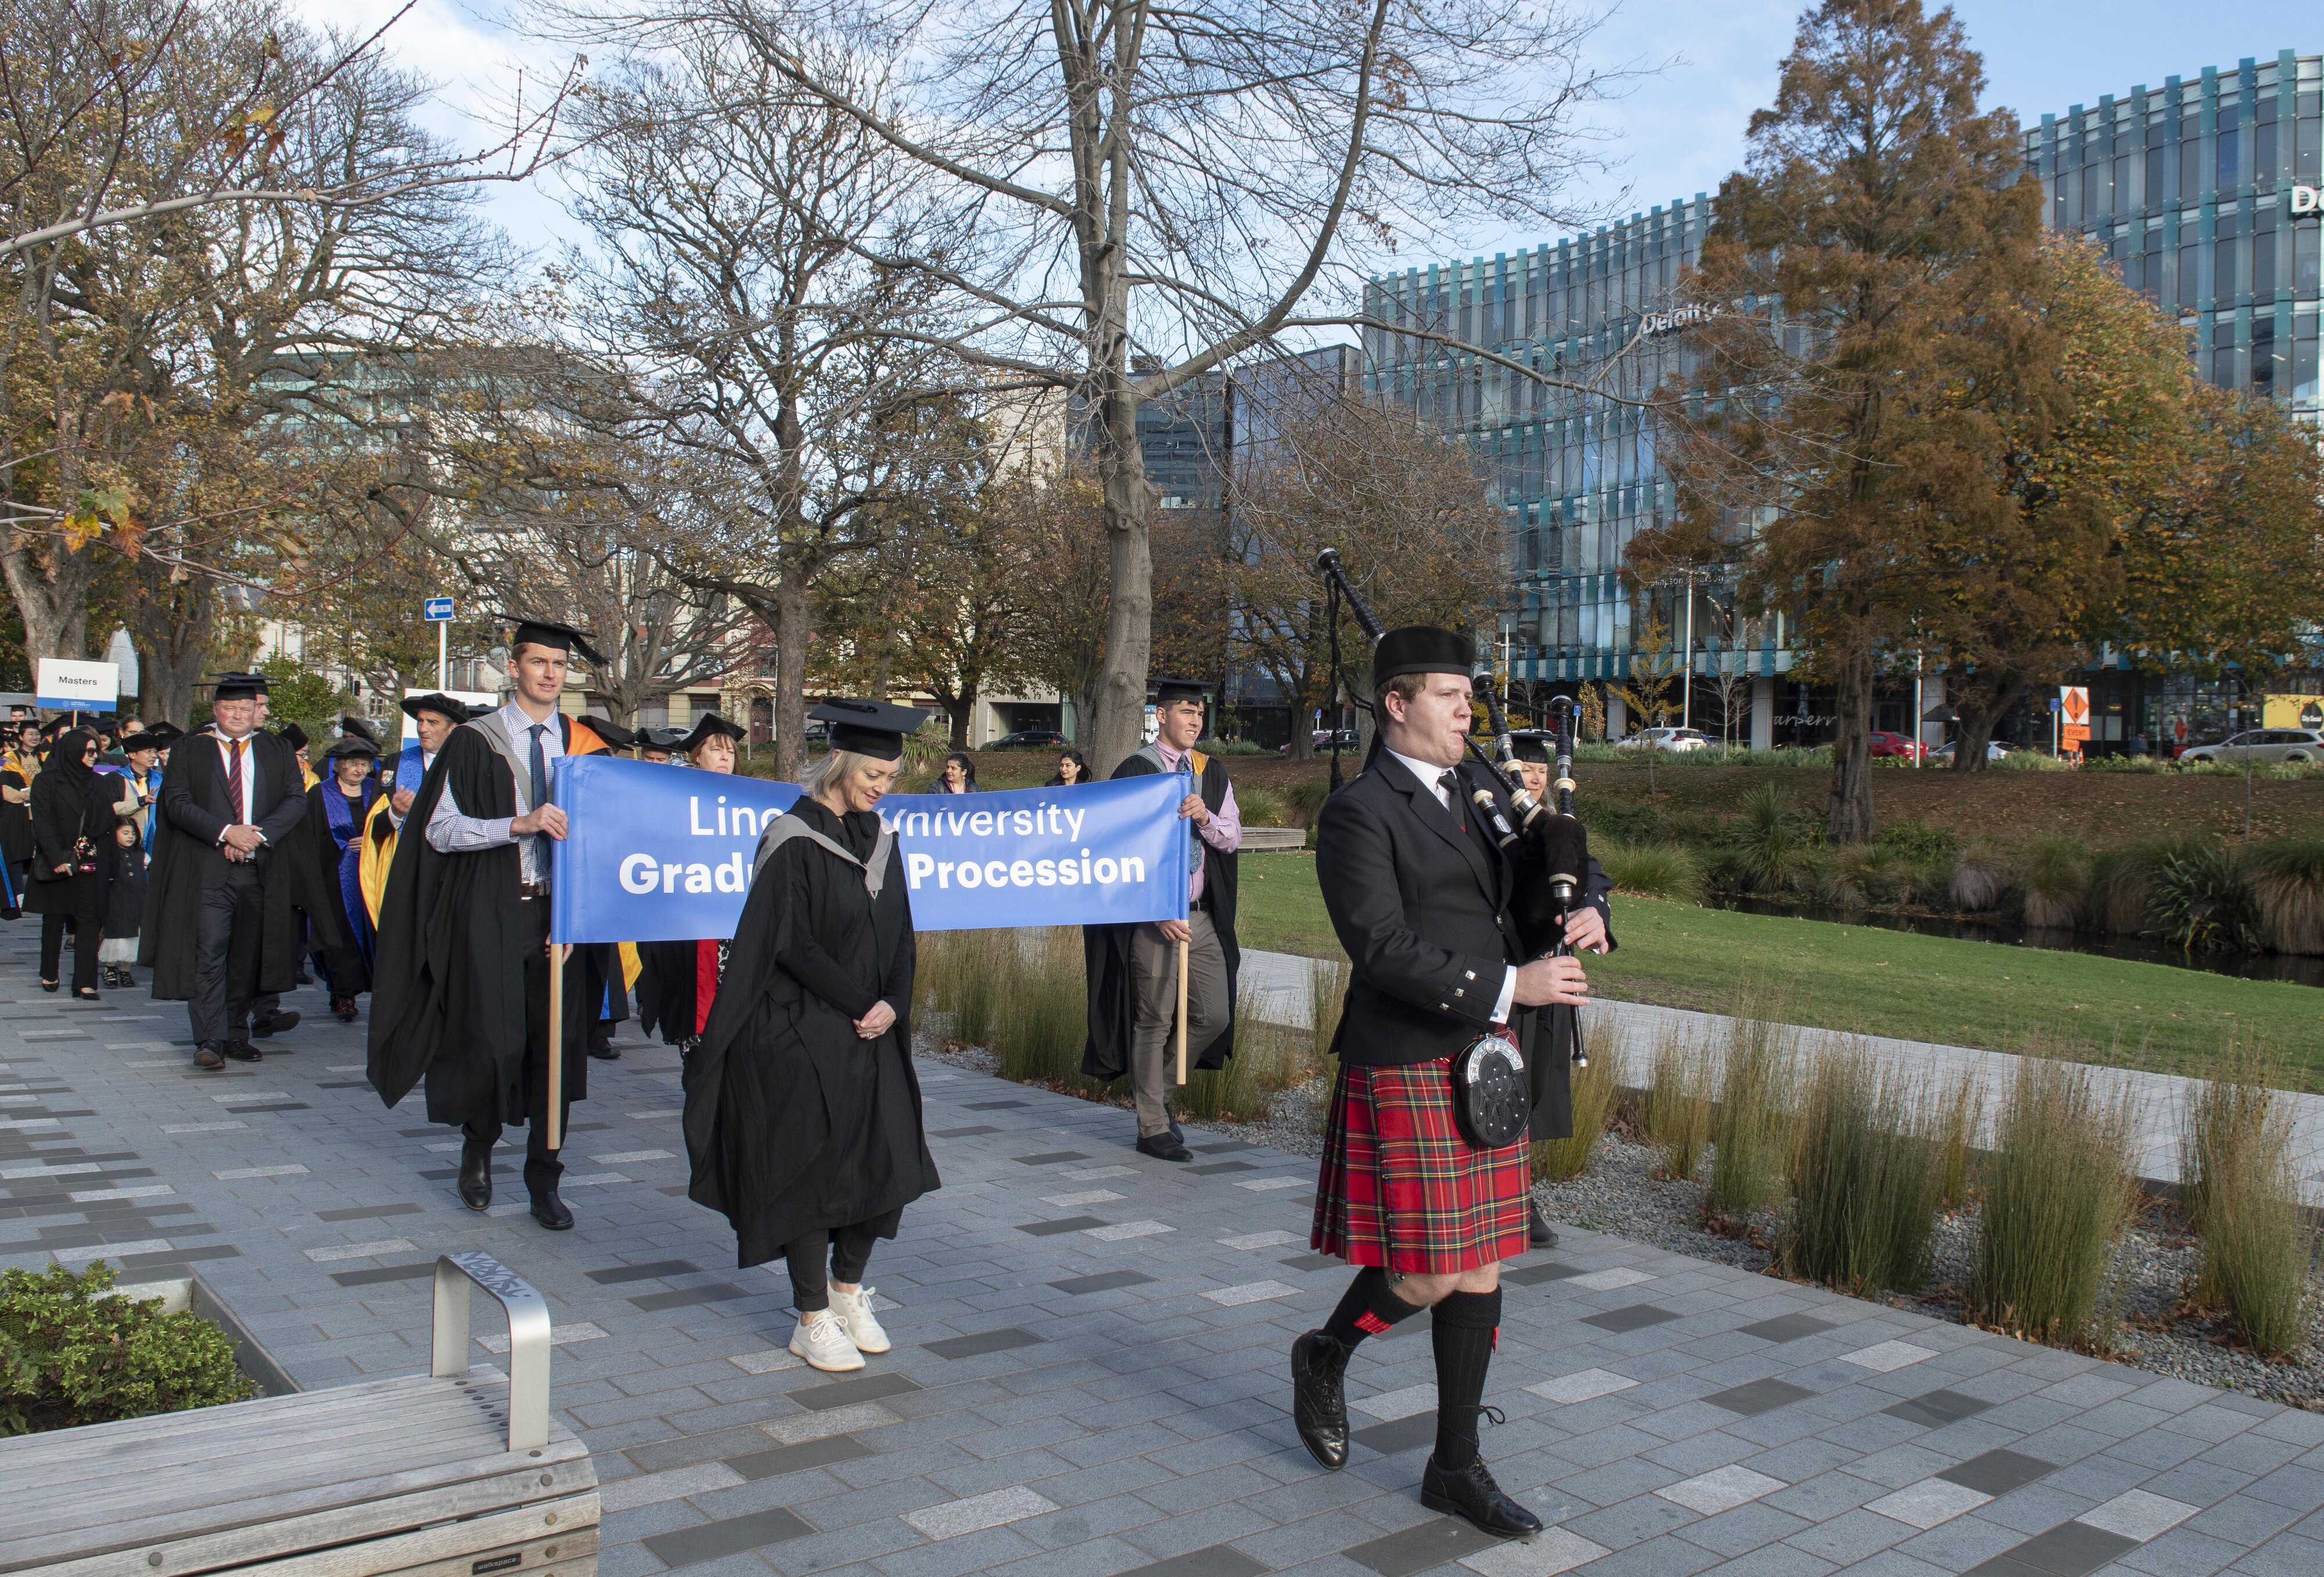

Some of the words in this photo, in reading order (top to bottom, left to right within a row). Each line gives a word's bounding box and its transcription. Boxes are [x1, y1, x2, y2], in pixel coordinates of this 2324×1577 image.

[59, 676, 98, 685] Masters
[620, 852, 754, 895] Grad
[908, 848, 1145, 890] Procession
[478, 1557, 517, 1570] walkspace
